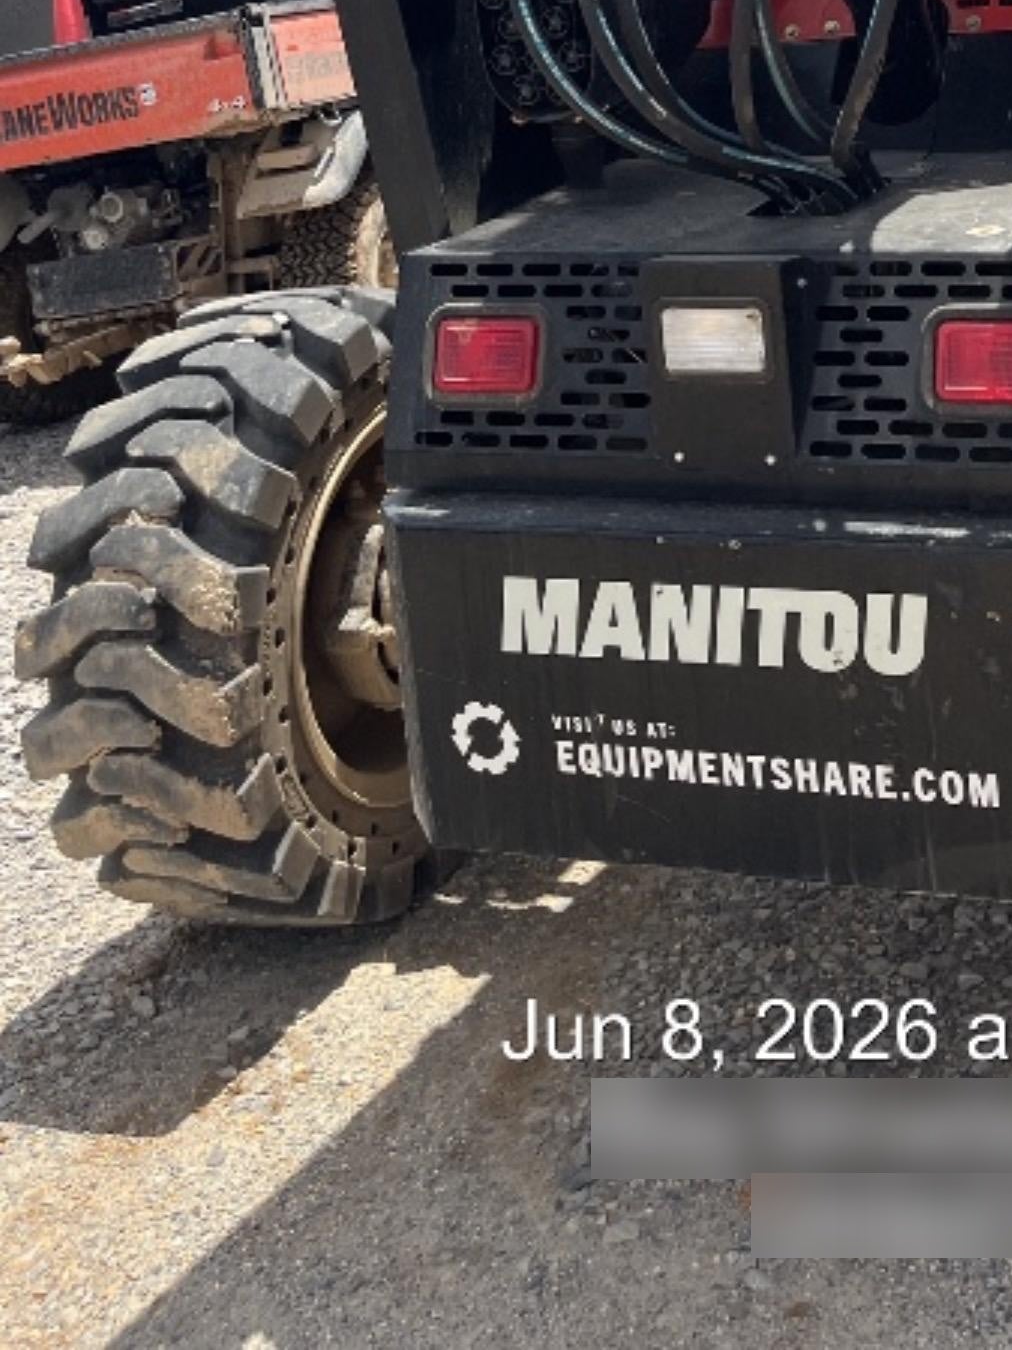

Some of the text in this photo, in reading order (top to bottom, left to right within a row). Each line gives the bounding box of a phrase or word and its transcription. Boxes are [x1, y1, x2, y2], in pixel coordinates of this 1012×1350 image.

[0, 86, 140, 142] ANEWORKS
[501, 576, 928, 676] MANITOU
[551, 713, 676, 740] VISIT US AT:
[555, 738, 1001, 809] EQUIPMENTSHARE.COM
